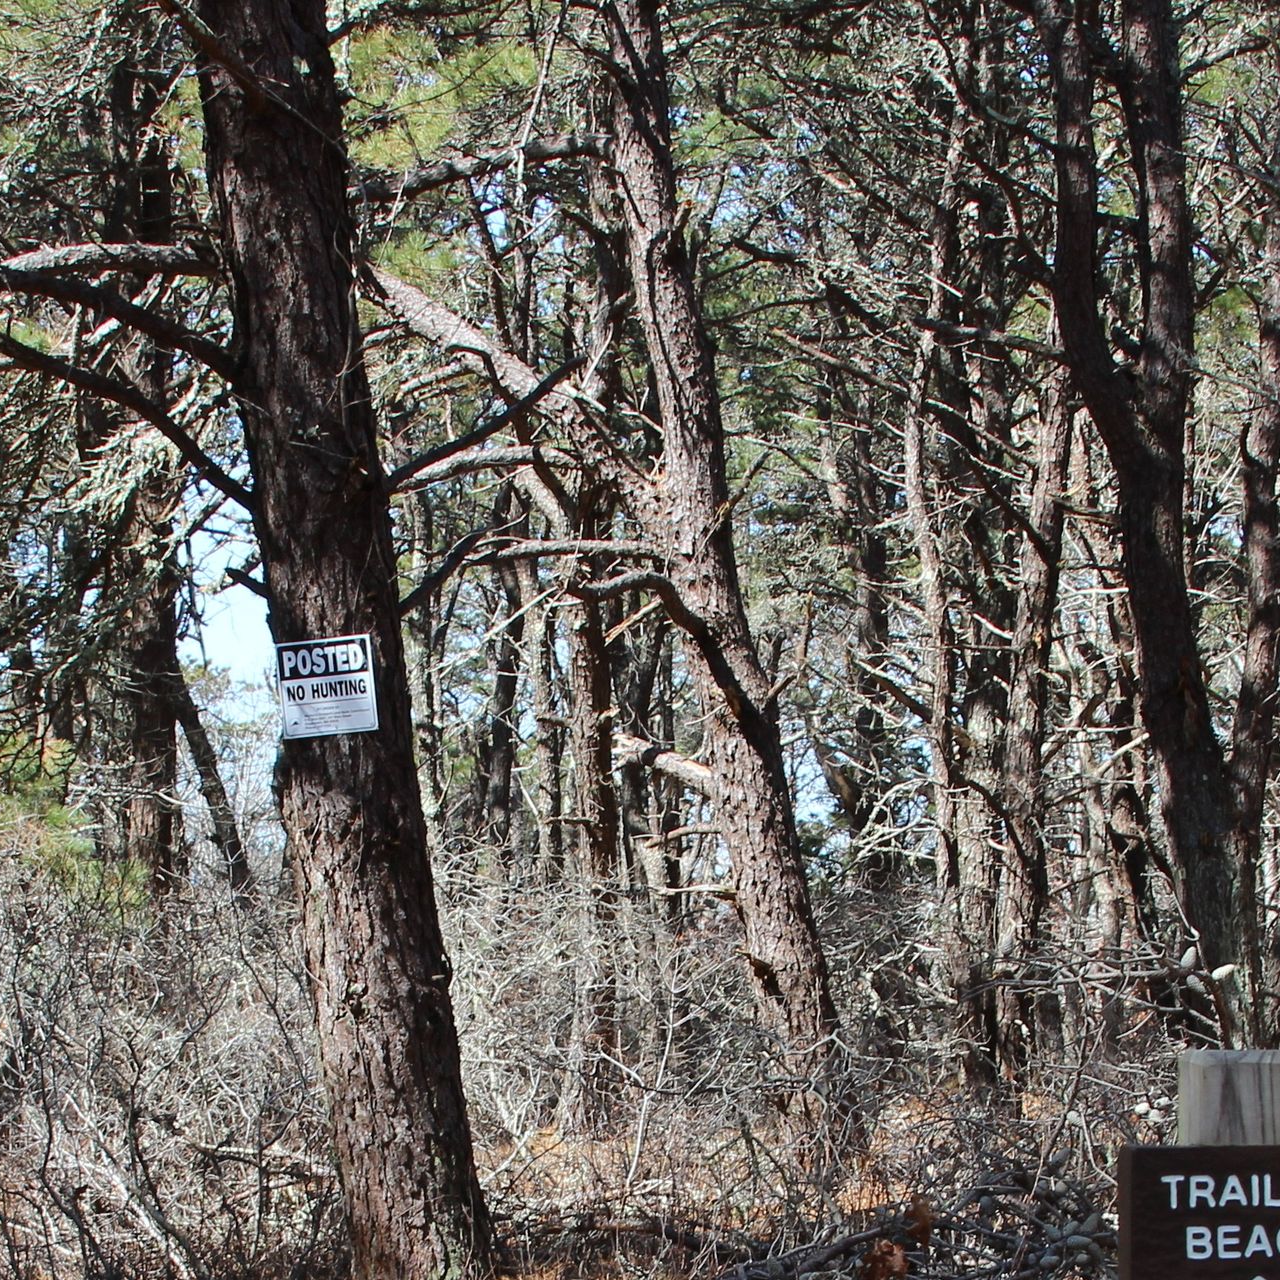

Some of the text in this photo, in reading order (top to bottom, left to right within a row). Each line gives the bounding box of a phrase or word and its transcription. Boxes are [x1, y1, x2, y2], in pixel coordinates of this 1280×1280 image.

[282, 643, 365, 678] POSTED
[286, 679, 367, 702] NO HUNTING
